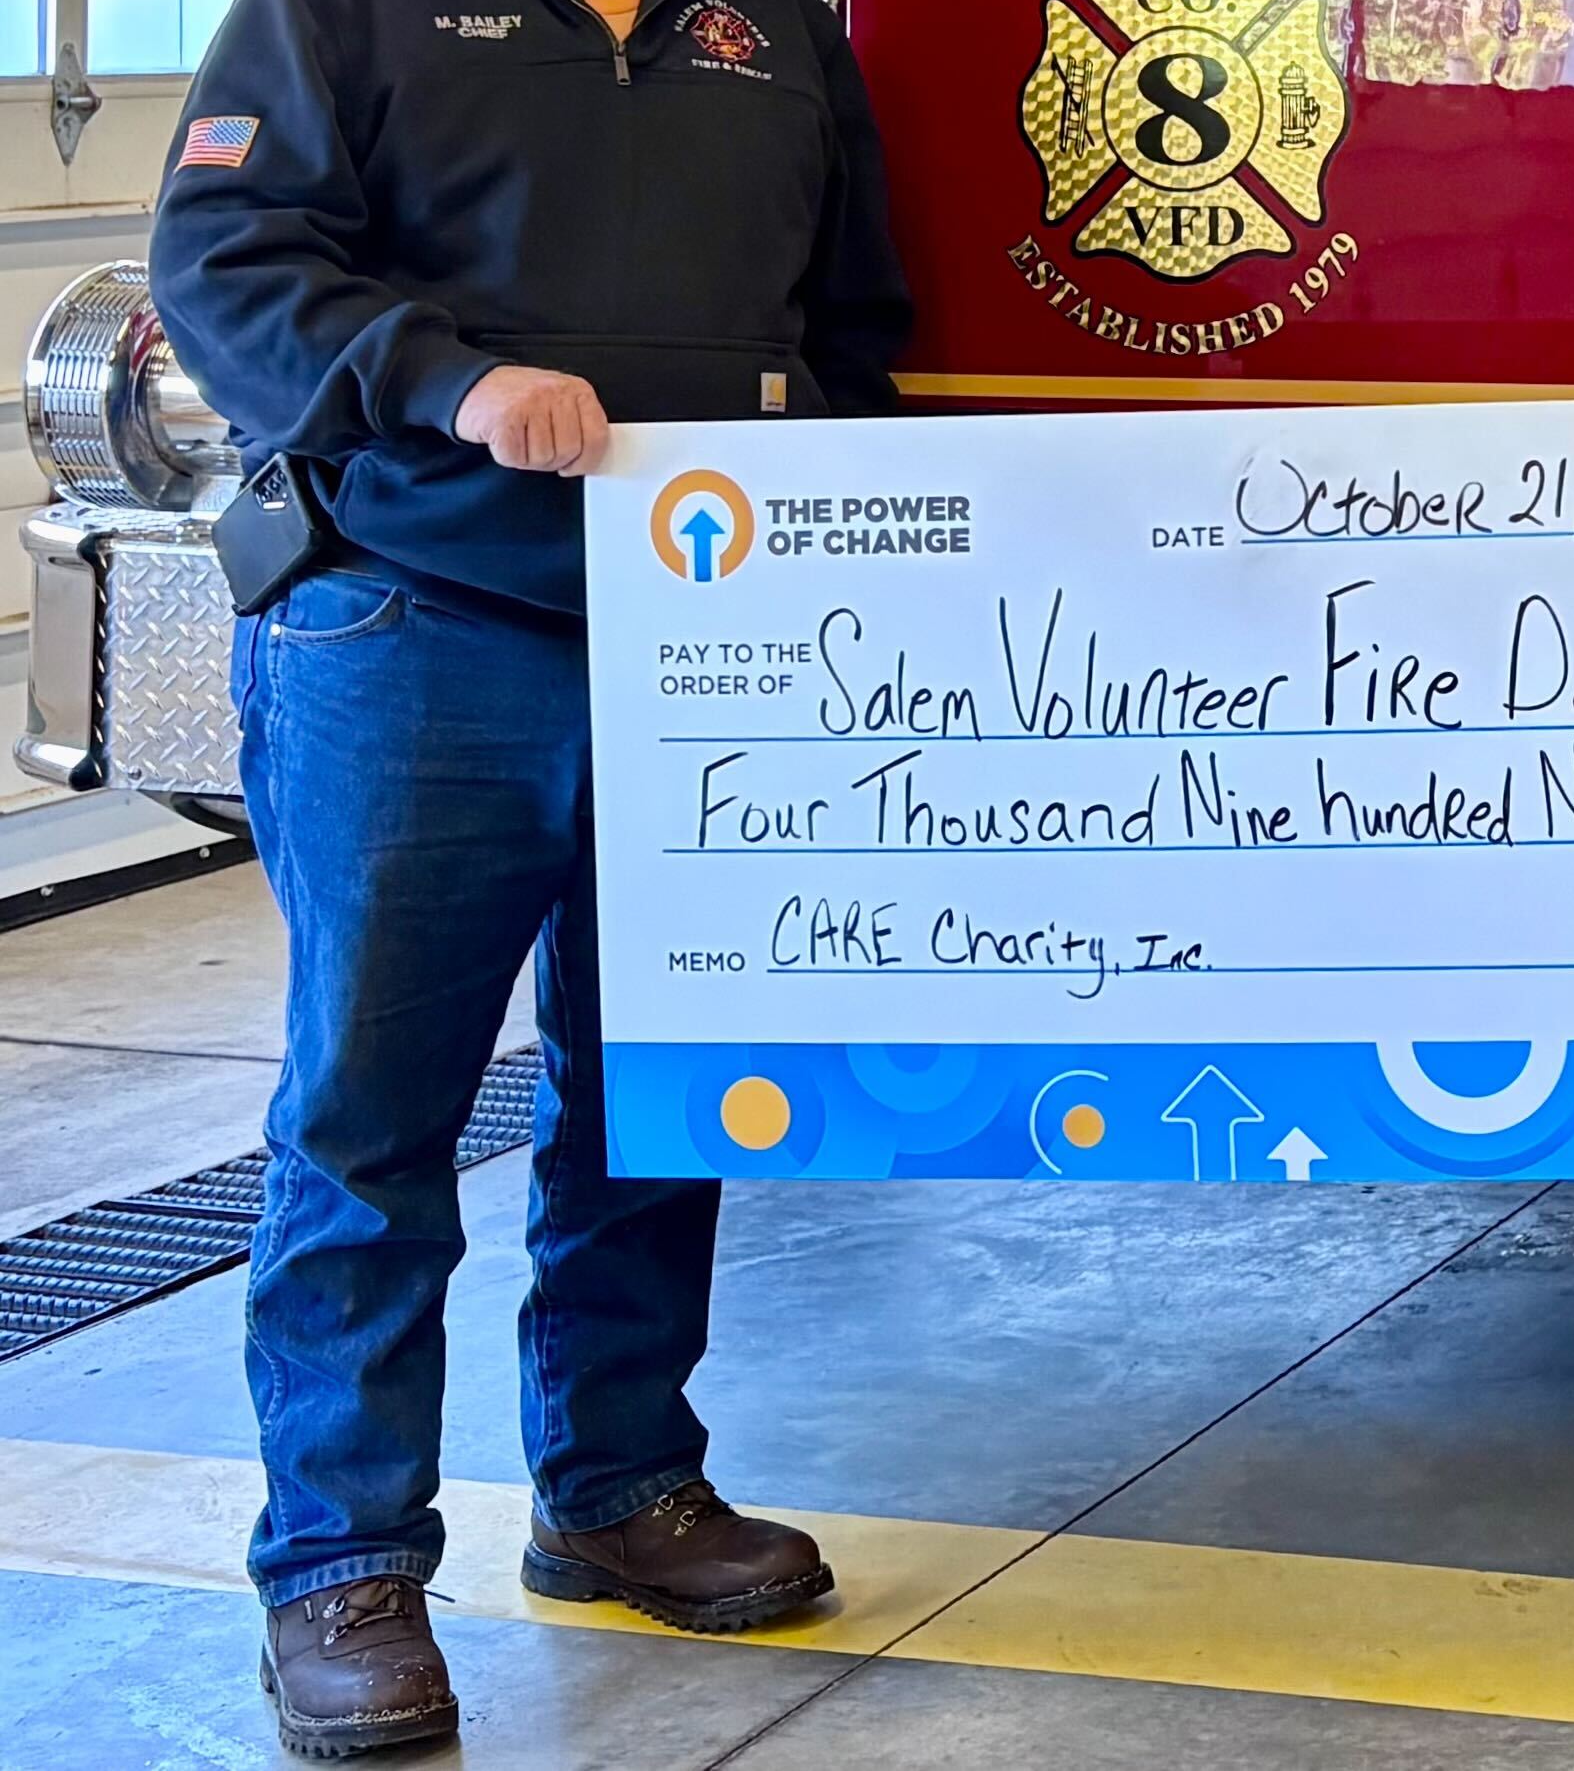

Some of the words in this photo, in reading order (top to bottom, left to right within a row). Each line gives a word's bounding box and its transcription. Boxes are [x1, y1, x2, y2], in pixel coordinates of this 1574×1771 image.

[434, 15, 457, 29] M.
[460, 14, 521, 29] BAILEY
[458, 27, 508, 39] CHIEF
[1135, 52, 1231, 167] 8
[1124, 205, 1246, 247] VFD
[1006, 233, 1286, 356] ESTABLISHED
[1287, 231, 1361, 315] 1979
[766, 498, 833, 524] THE
[842, 495, 970, 523] POWER
[766, 529, 812, 556] OF
[823, 527, 971, 555] CHANGE
[1152, 526, 1225, 548] DATE
[660, 644, 709, 665] PAY
[718, 644, 753, 664] TO
[761, 643, 812, 664] THE
[819, 607, 981, 742] Salem
[999, 588, 1289, 738] Volunteer
[660, 675, 747, 695] ORDER
[758, 674, 793, 695] OF
[699, 751, 829, 849] Four
[851, 749, 1161, 848] Thousand
[1181, 748, 1299, 848] Nine
[771, 894, 902, 967] CARE
[931, 905, 1121, 999] Charity,
[1133, 933, 1212, 973] Inc.
[669, 951, 745, 972] MEMO
